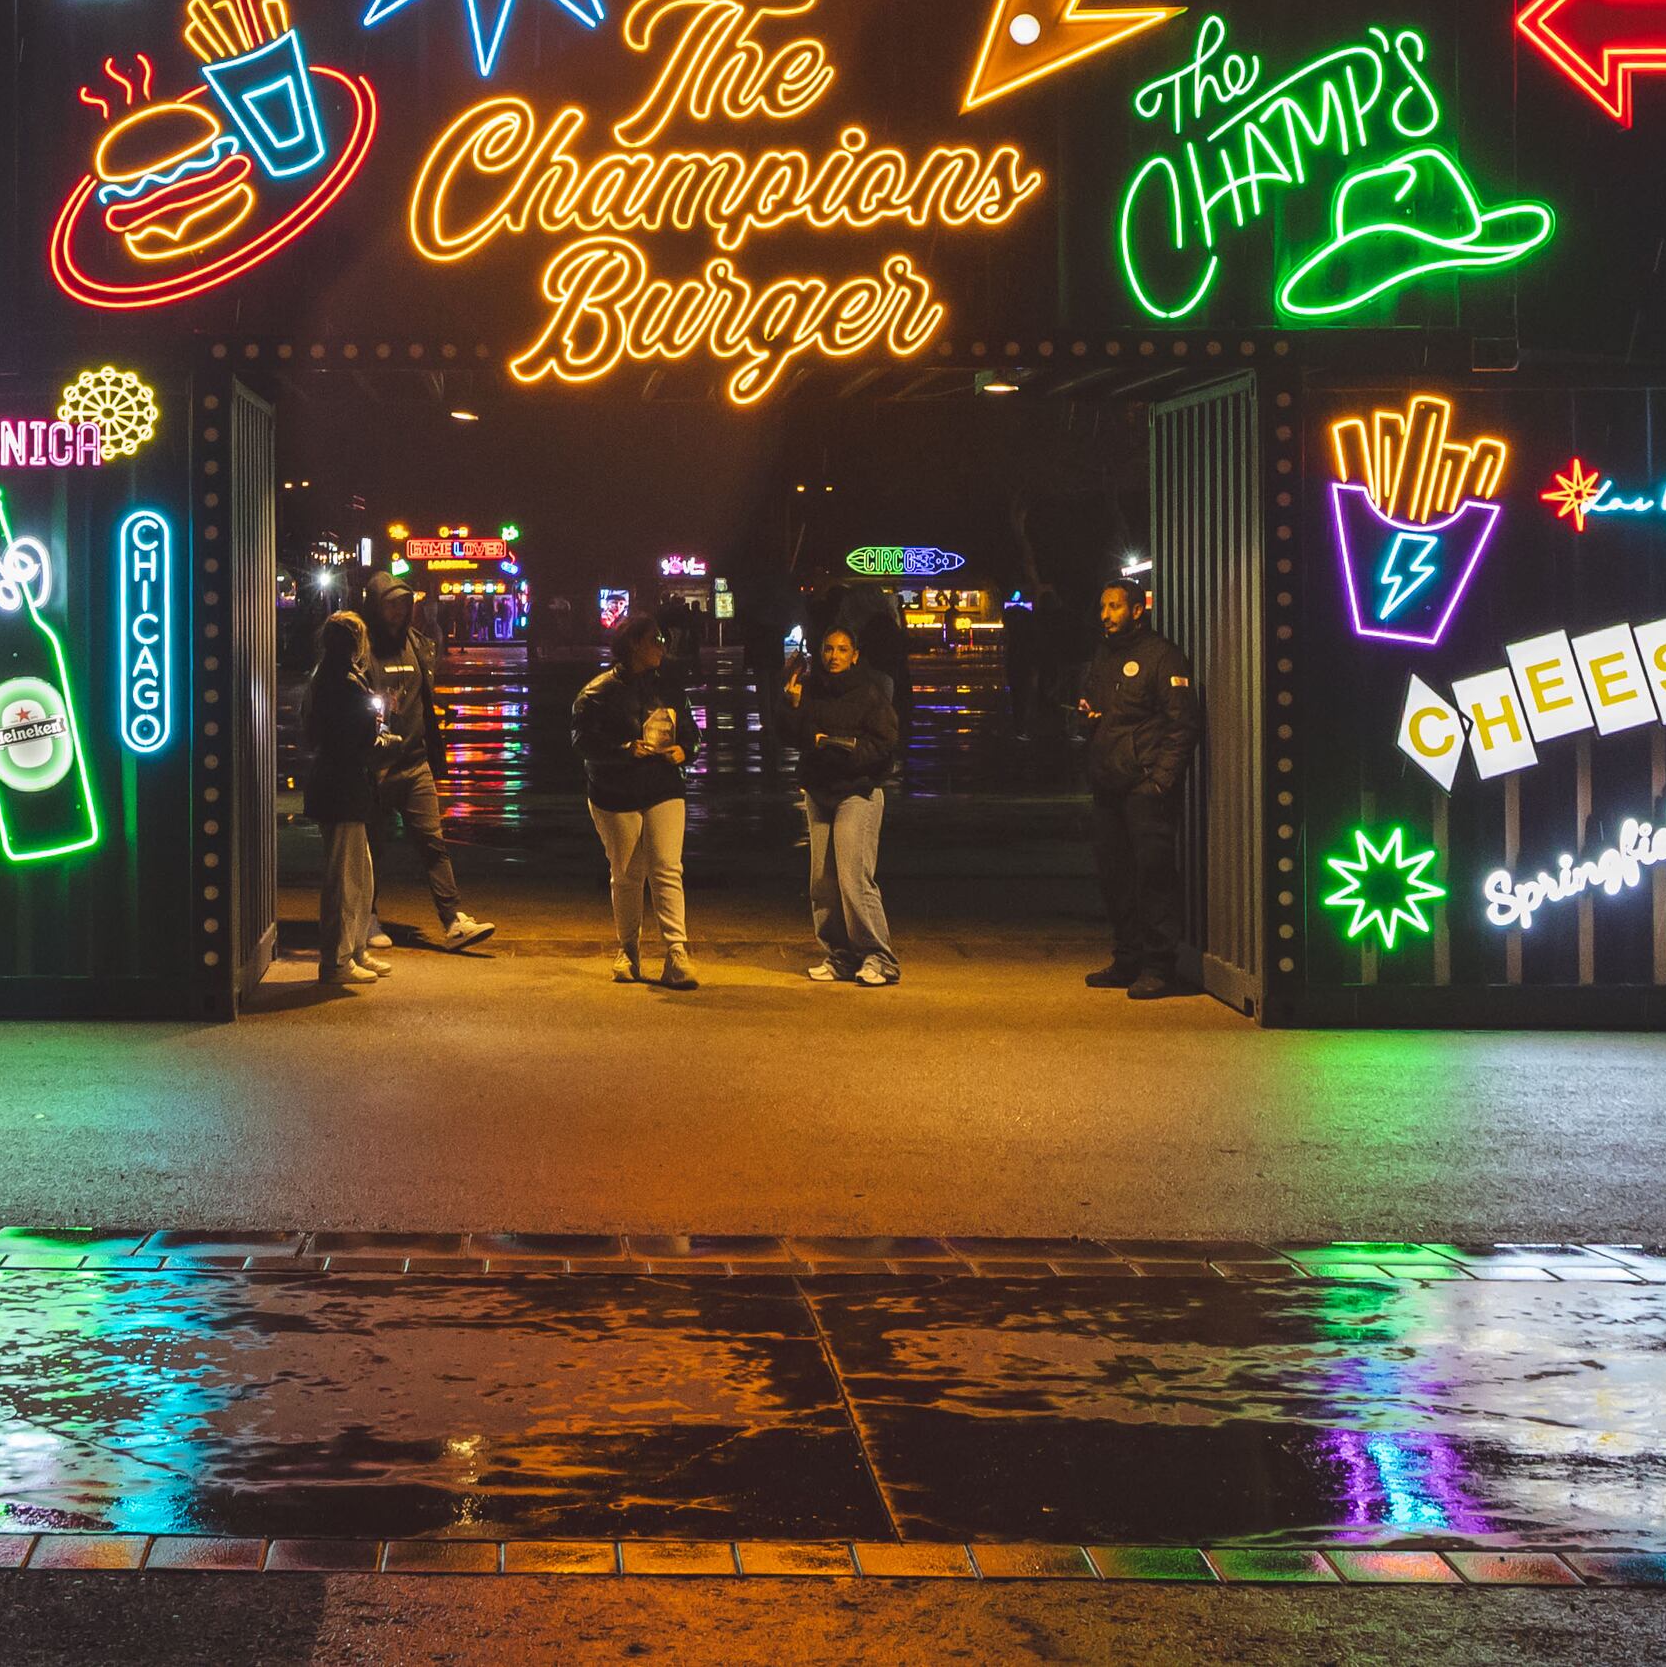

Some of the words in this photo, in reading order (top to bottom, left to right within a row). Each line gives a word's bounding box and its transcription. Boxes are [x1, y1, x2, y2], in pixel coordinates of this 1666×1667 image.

[1135, 15, 1260, 134] The
[410, 97, 1042, 261] Champions
[1121, 27, 1440, 318] CHAMP'S
[511, 236, 944, 405] Burger
[410, 541, 452, 556] GAME
[1581, 480, 1654, 514] Las
[130, 519, 162, 746] CHICAGO
